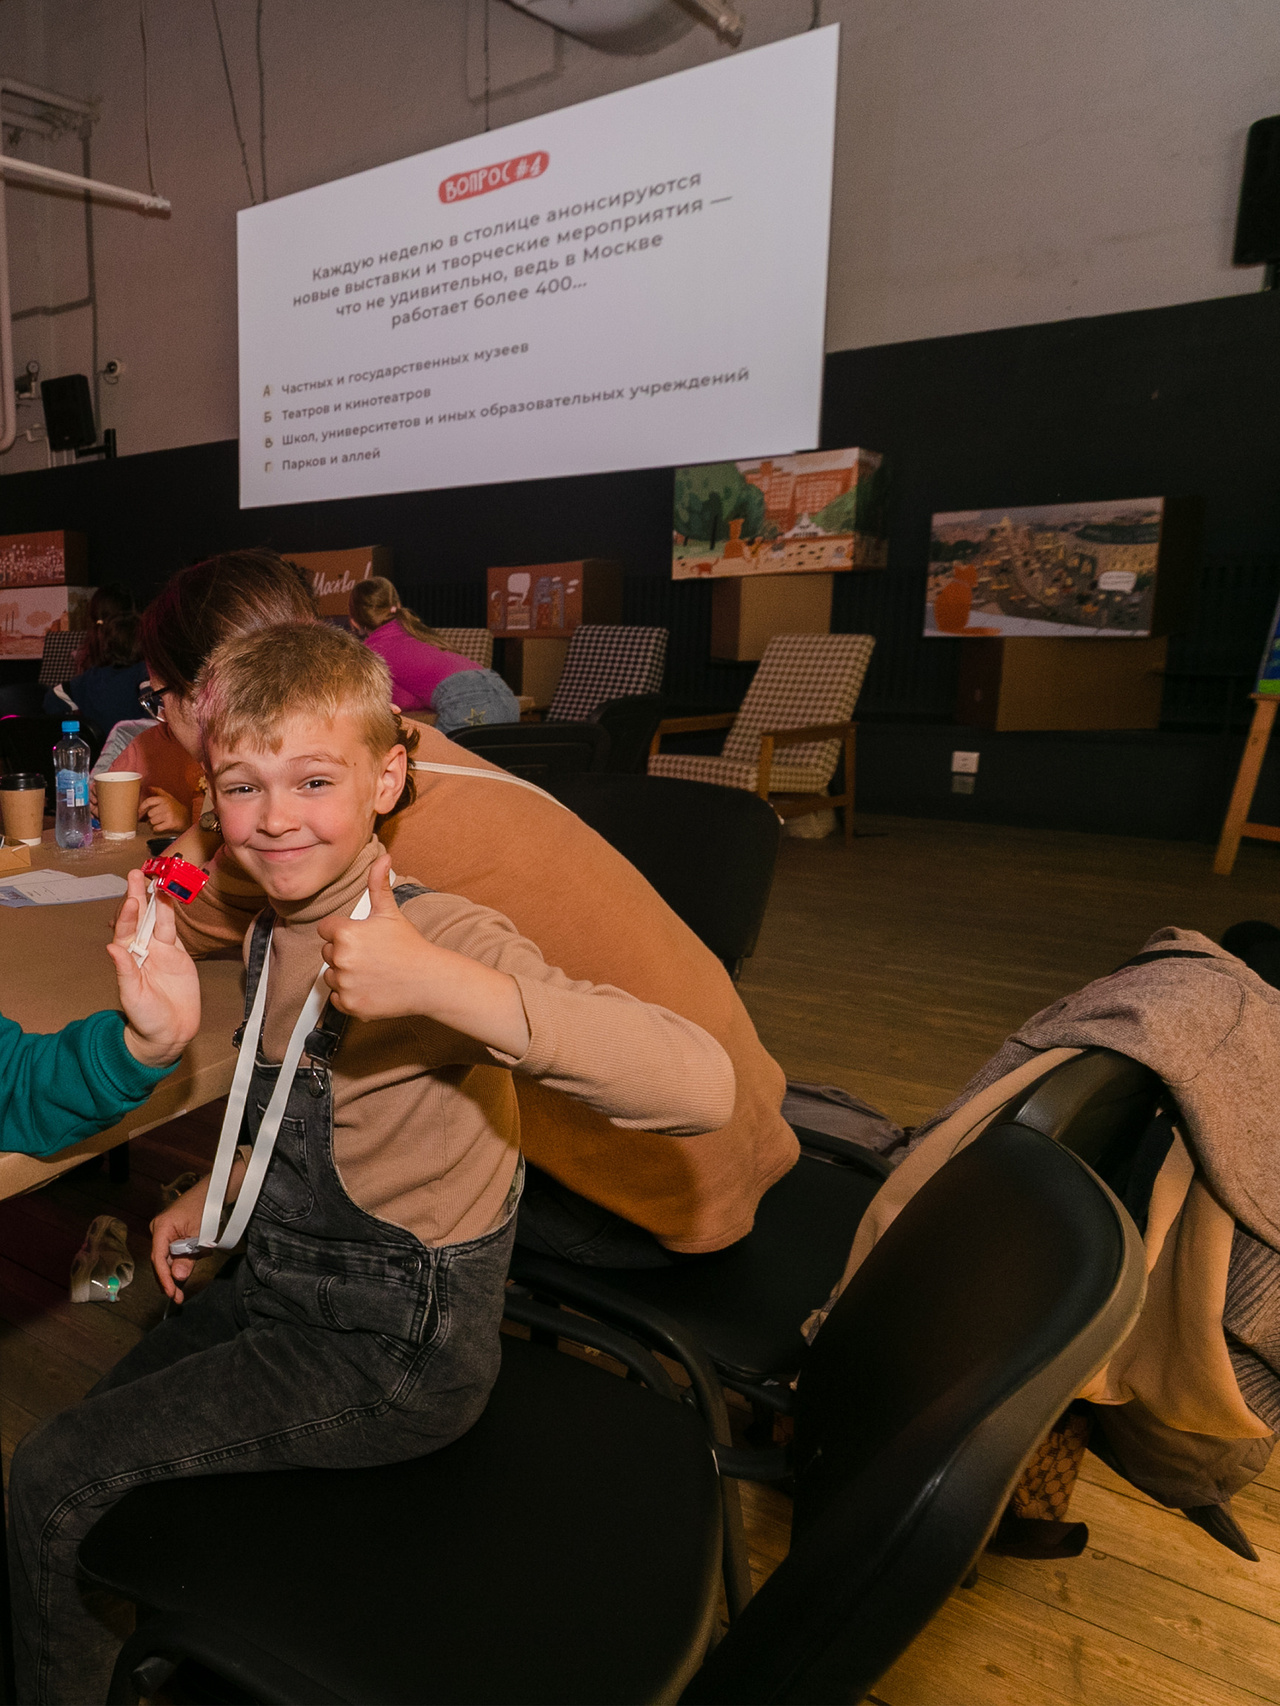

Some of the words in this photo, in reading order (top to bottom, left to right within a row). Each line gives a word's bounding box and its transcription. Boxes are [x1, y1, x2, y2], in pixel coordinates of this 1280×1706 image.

[445, 160, 511, 202] ВОПРОС
[515, 154, 542, 180] #4
[292, 286, 340, 307] новые
[345, 266, 421, 294] выставки
[426, 262, 436, 275] и
[442, 235, 550, 271] творческие
[556, 198, 703, 244] мероприятия
[312, 256, 374, 281] Каждую
[379, 238, 443, 264] неделю
[449, 234, 458, 247] в
[464, 213, 540, 243] столице
[546, 172, 702, 223] анонсируются
[336, 303, 362, 317] что
[366, 296, 385, 310] не
[390, 268, 509, 308] удивительно,
[514, 257, 559, 279] ведь
[565, 252, 576, 267] в
[583, 233, 663, 263] Москве
[391, 298, 469, 329] работает
[474, 286, 529, 309] более
[535, 275, 587, 296] 400...
[263, 384, 272, 397] А
[282, 377, 333, 395] Частных
[337, 376, 345, 386] и
[348, 351, 470, 383] государственных
[474, 342, 529, 362] музеев
[263, 411, 272, 423] Б
[282, 404, 330, 421] Театров
[333, 402, 342, 412] и
[345, 387, 431, 410] кинотеатров
[265, 437, 273, 448] В
[282, 432, 318, 446] Школ,
[321, 416, 421, 443] университетов
[425, 415, 434, 426] и
[438, 408, 476, 424] иных
[480, 388, 624, 418] образовательных
[629, 366, 750, 400] учреждений
[282, 457, 326, 471] Парков
[330, 455, 338, 465] и
[341, 448, 381, 463] аллей
